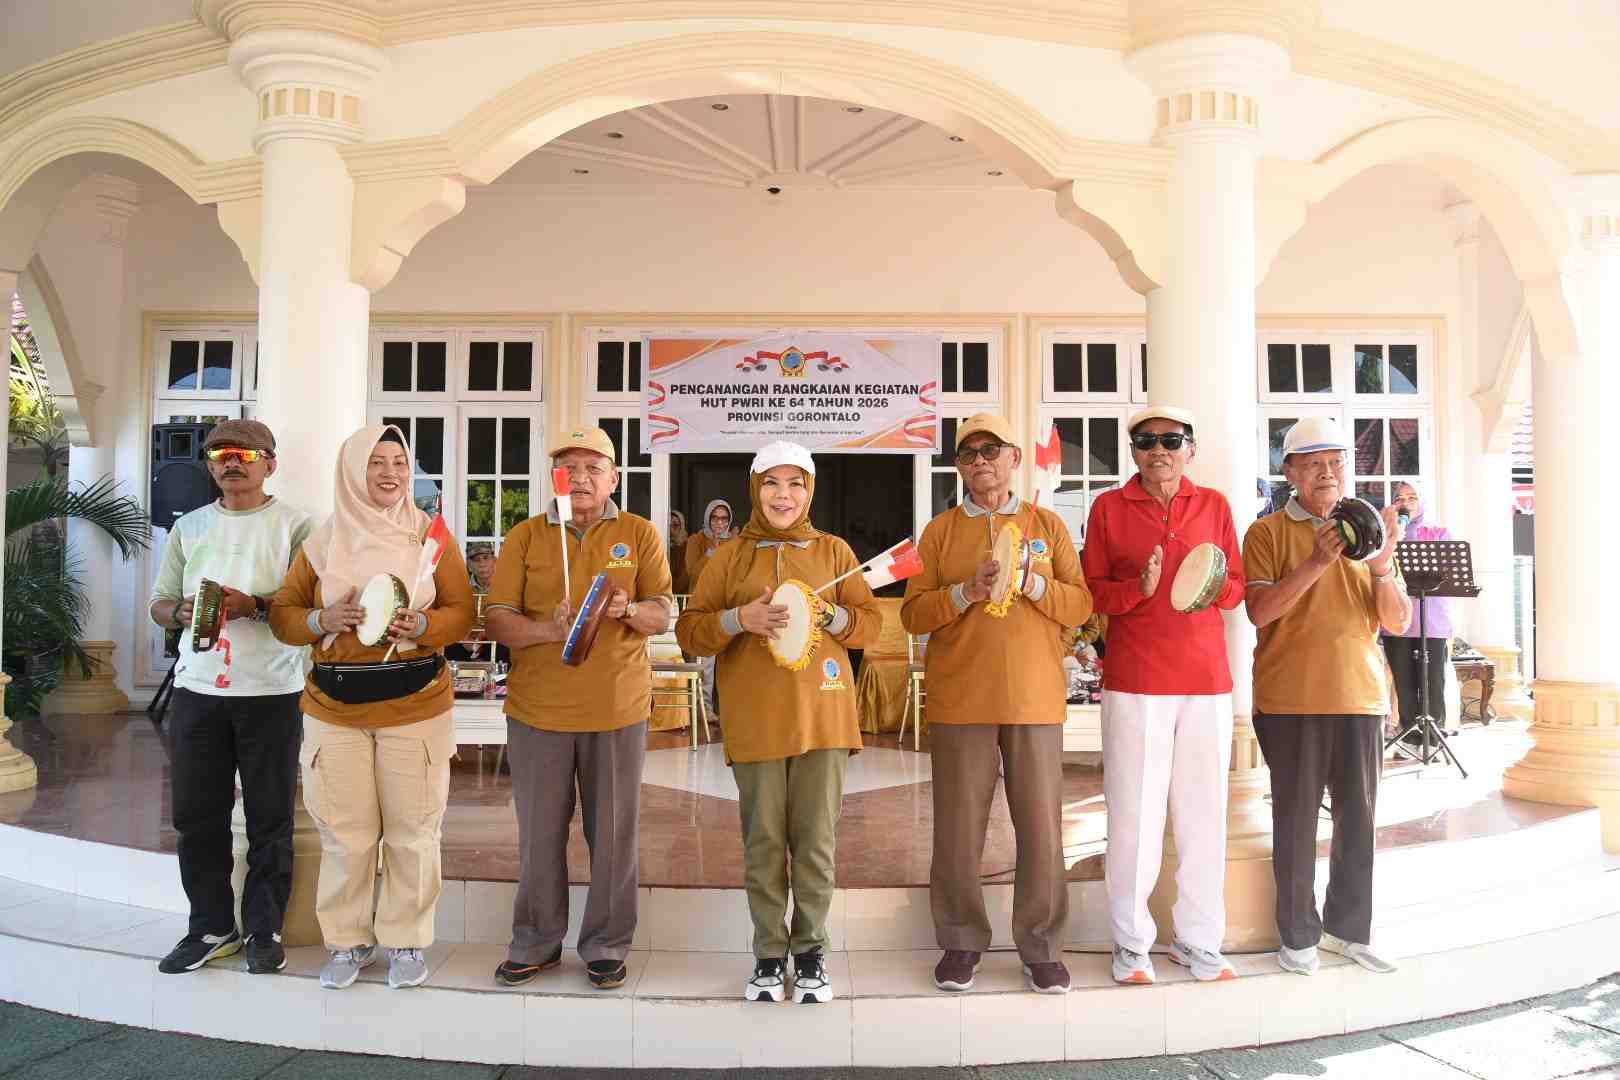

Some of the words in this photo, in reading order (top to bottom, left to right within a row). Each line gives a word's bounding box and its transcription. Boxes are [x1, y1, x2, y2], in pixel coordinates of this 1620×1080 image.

[670, 384, 768, 395] PENCANANGAN
[772, 384, 850, 395] RANGKAIAN
[854, 384, 919, 395] KEGIATAN
[700, 398, 728, 408] HUT
[731, 398, 765, 408] PWRI
[768, 398, 786, 408] KE
[789, 398, 805, 408] 64
[808, 398, 853, 408] TAHUN
[856, 398, 889, 408] 2026
[727, 413, 783, 422] PROVINSI
[787, 413, 861, 422] GORONTALO
